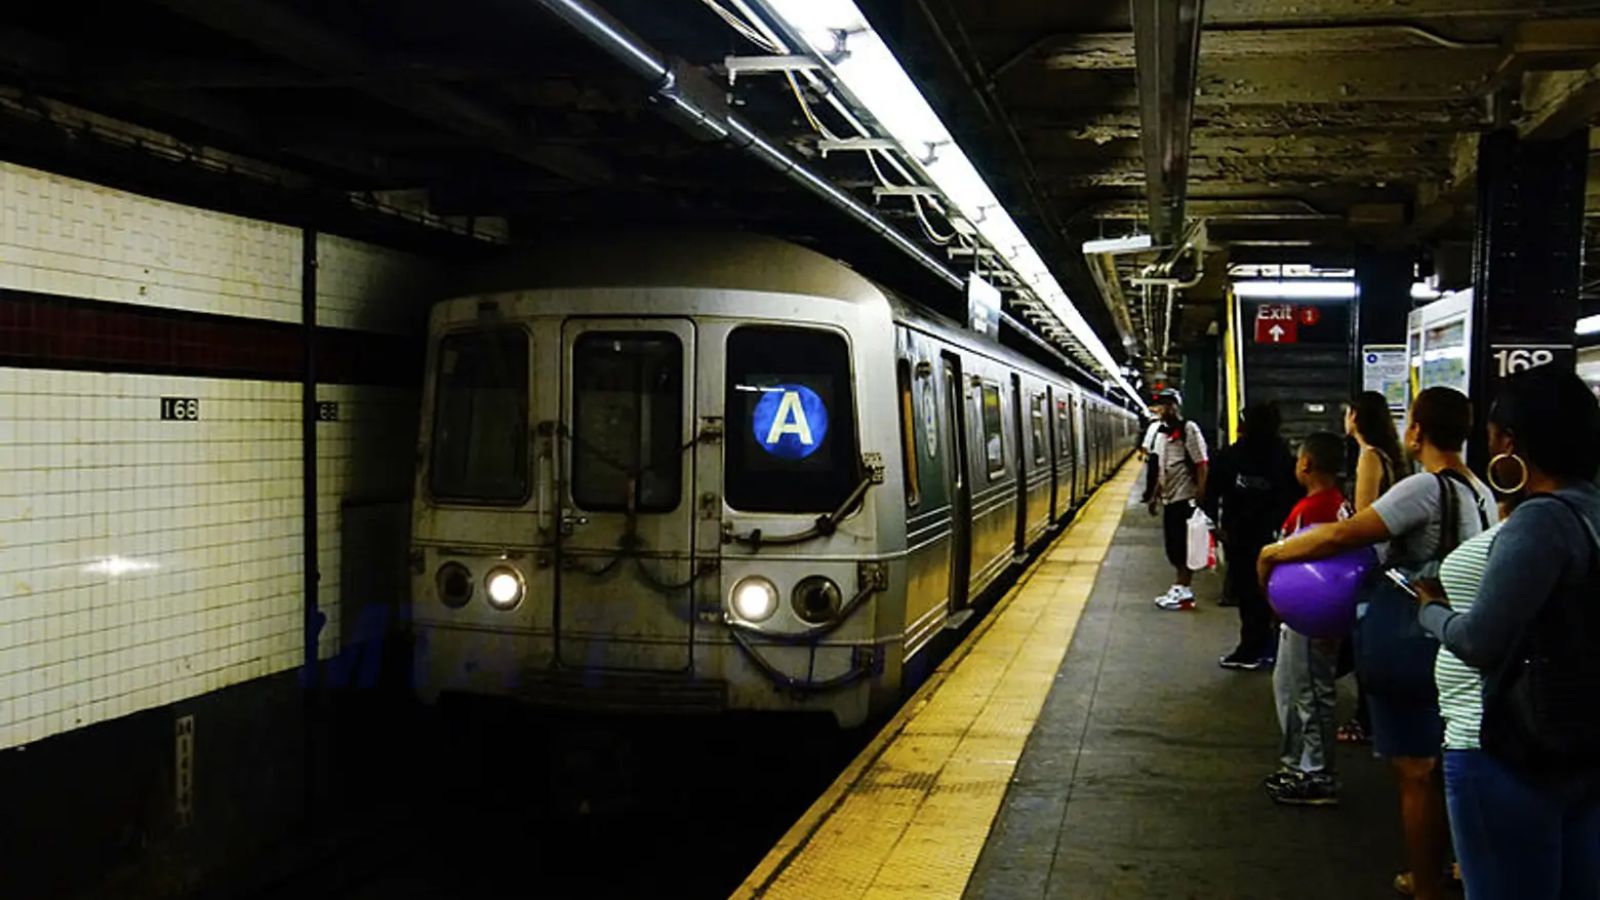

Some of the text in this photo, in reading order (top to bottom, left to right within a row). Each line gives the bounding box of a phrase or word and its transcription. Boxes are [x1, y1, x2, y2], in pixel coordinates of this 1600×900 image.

[1257, 304, 1293, 320] Exit
[165, 400, 198, 419] 168
[766, 391, 813, 445] A
